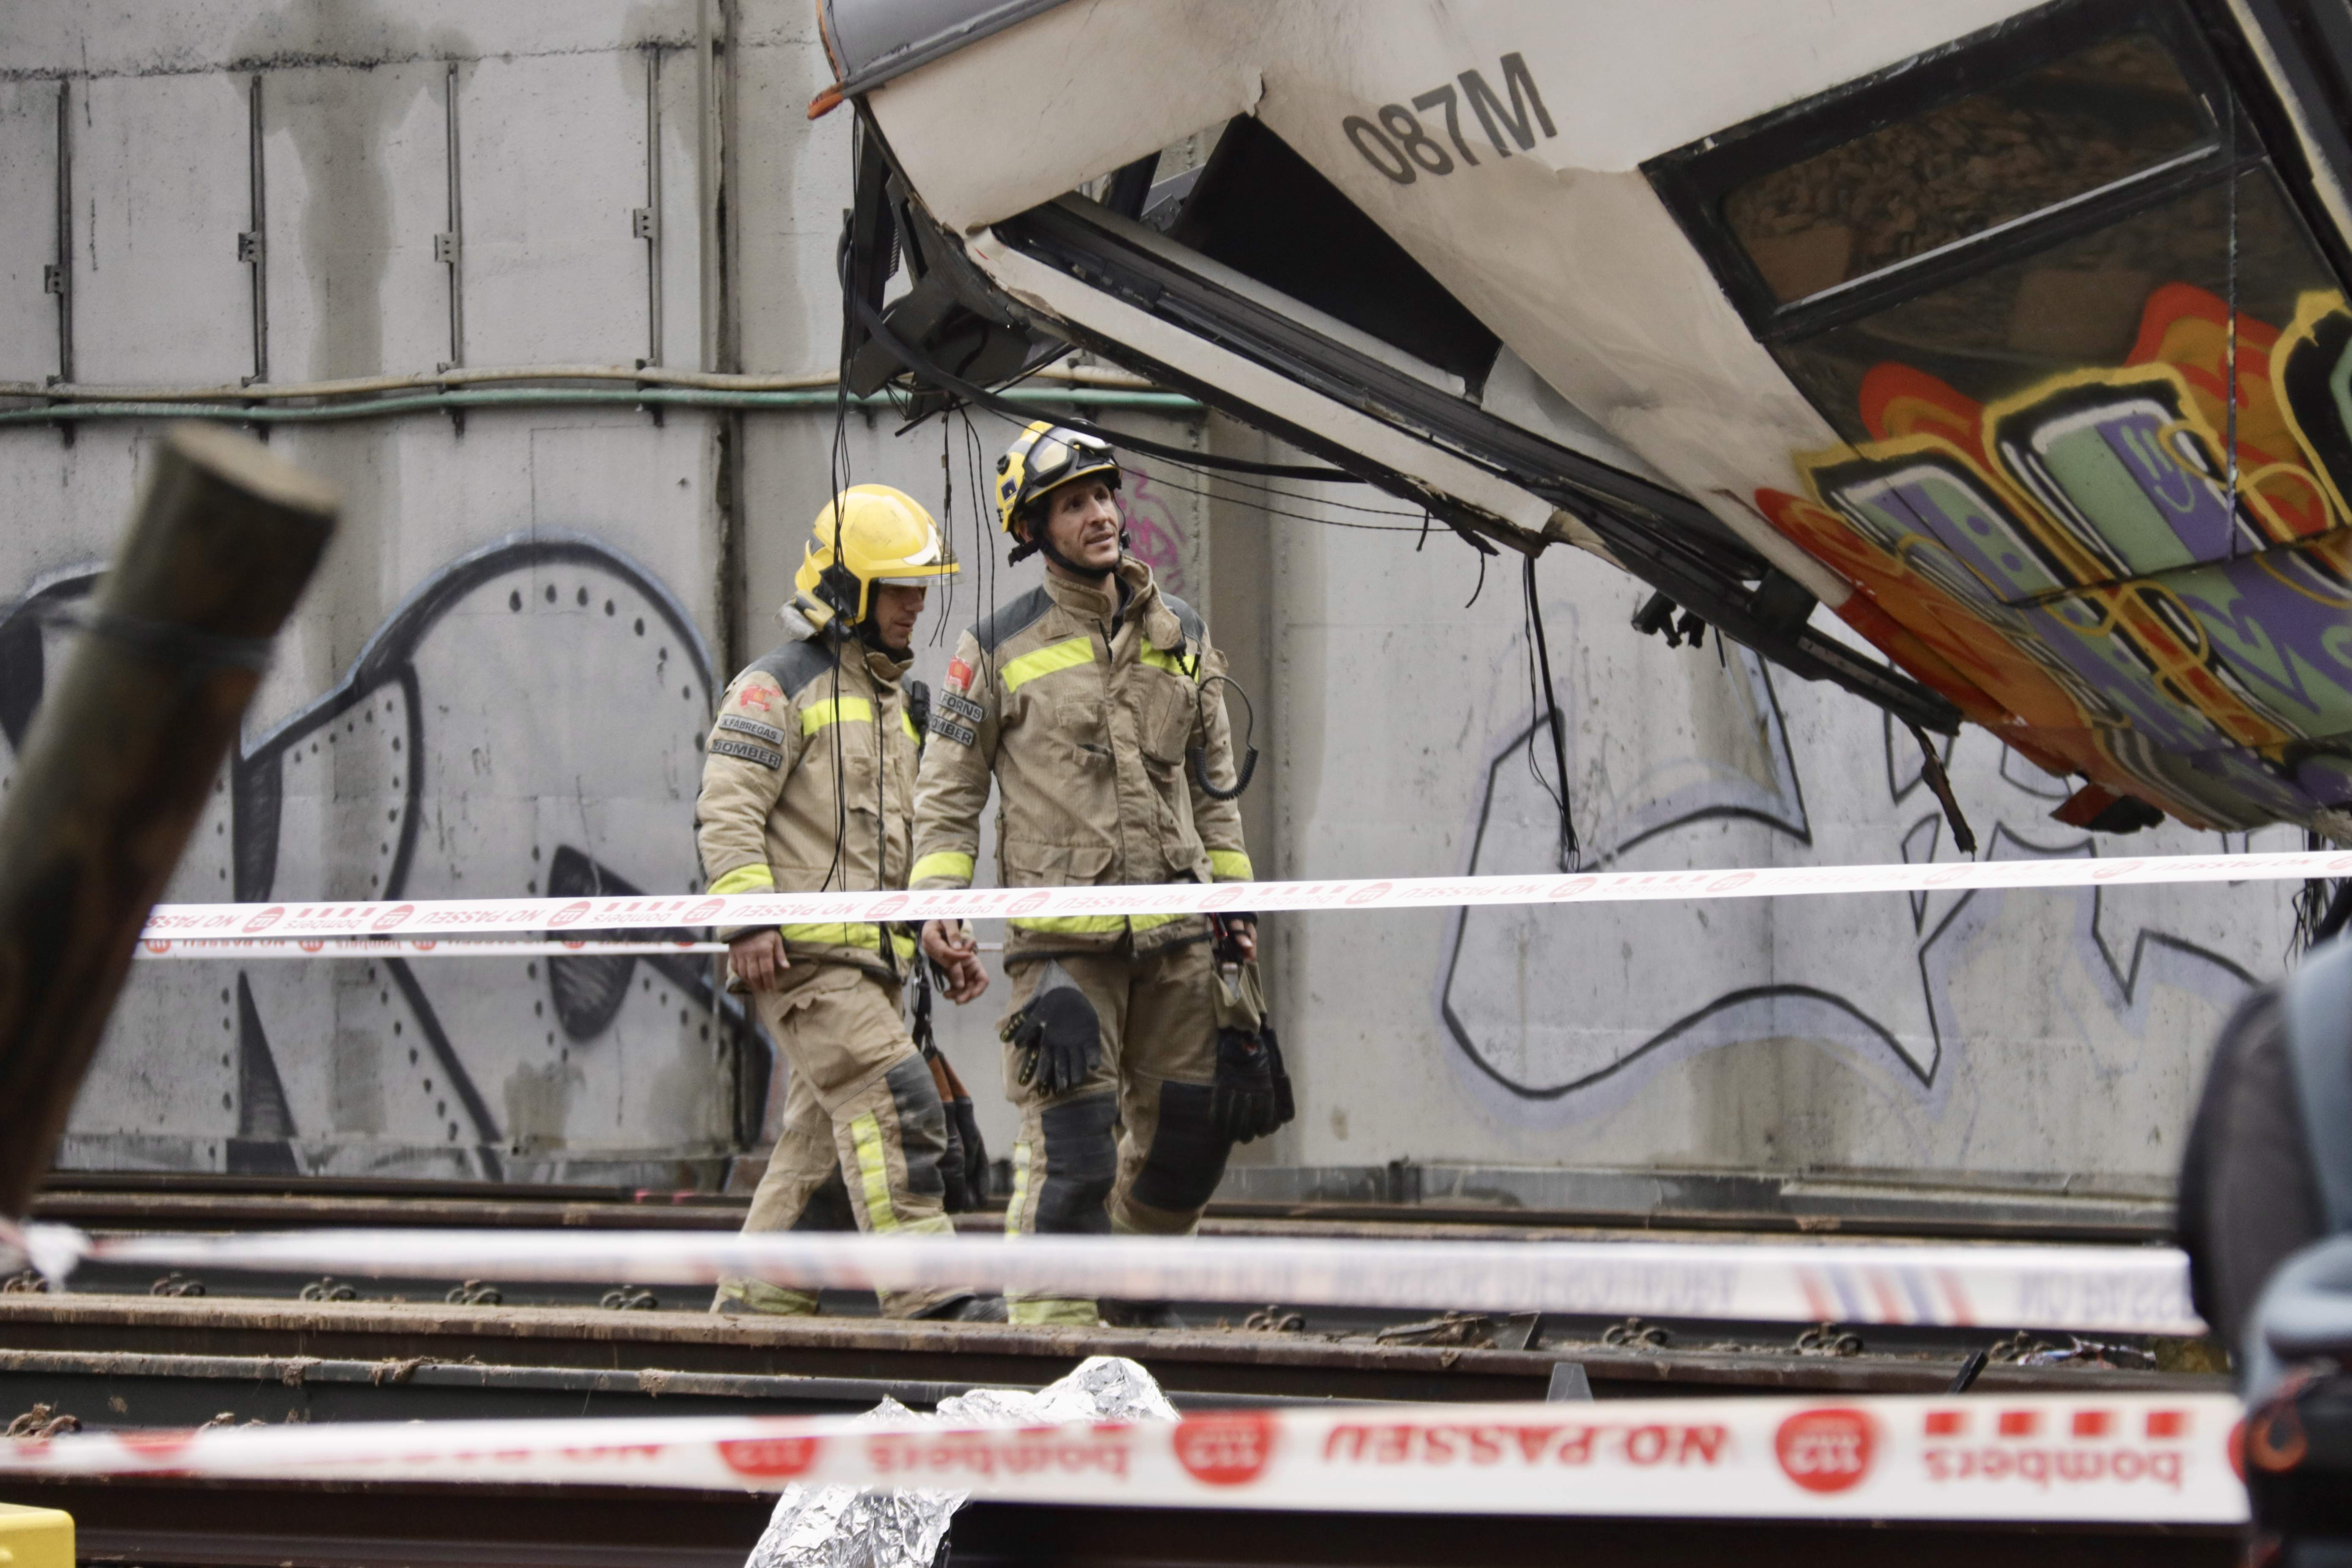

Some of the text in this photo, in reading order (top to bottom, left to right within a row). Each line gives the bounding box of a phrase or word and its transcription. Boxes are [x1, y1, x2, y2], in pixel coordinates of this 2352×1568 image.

[1342, 51, 1558, 184] 087M
[941, 694, 982, 719] FORNS
[713, 742, 779, 766] BOMBER
[727, 903, 865, 917] NO PASSEU
[909, 905, 997, 916] bombers
[1052, 895, 1195, 909] NO PASSEU
[203, 914, 244, 927] NO
[283, 919, 364, 930] bombers
[414, 909, 548, 924] NO PASSEU
[589, 912, 674, 924] bombers
[1189, 1431, 1260, 1470] 112
[1323, 1423, 1730, 1466] NO PASSEU
[1789, 1435, 1862, 1474] 112
[869, 1440, 1131, 1480] bombers
[1925, 1449, 2182, 1491] bombers
